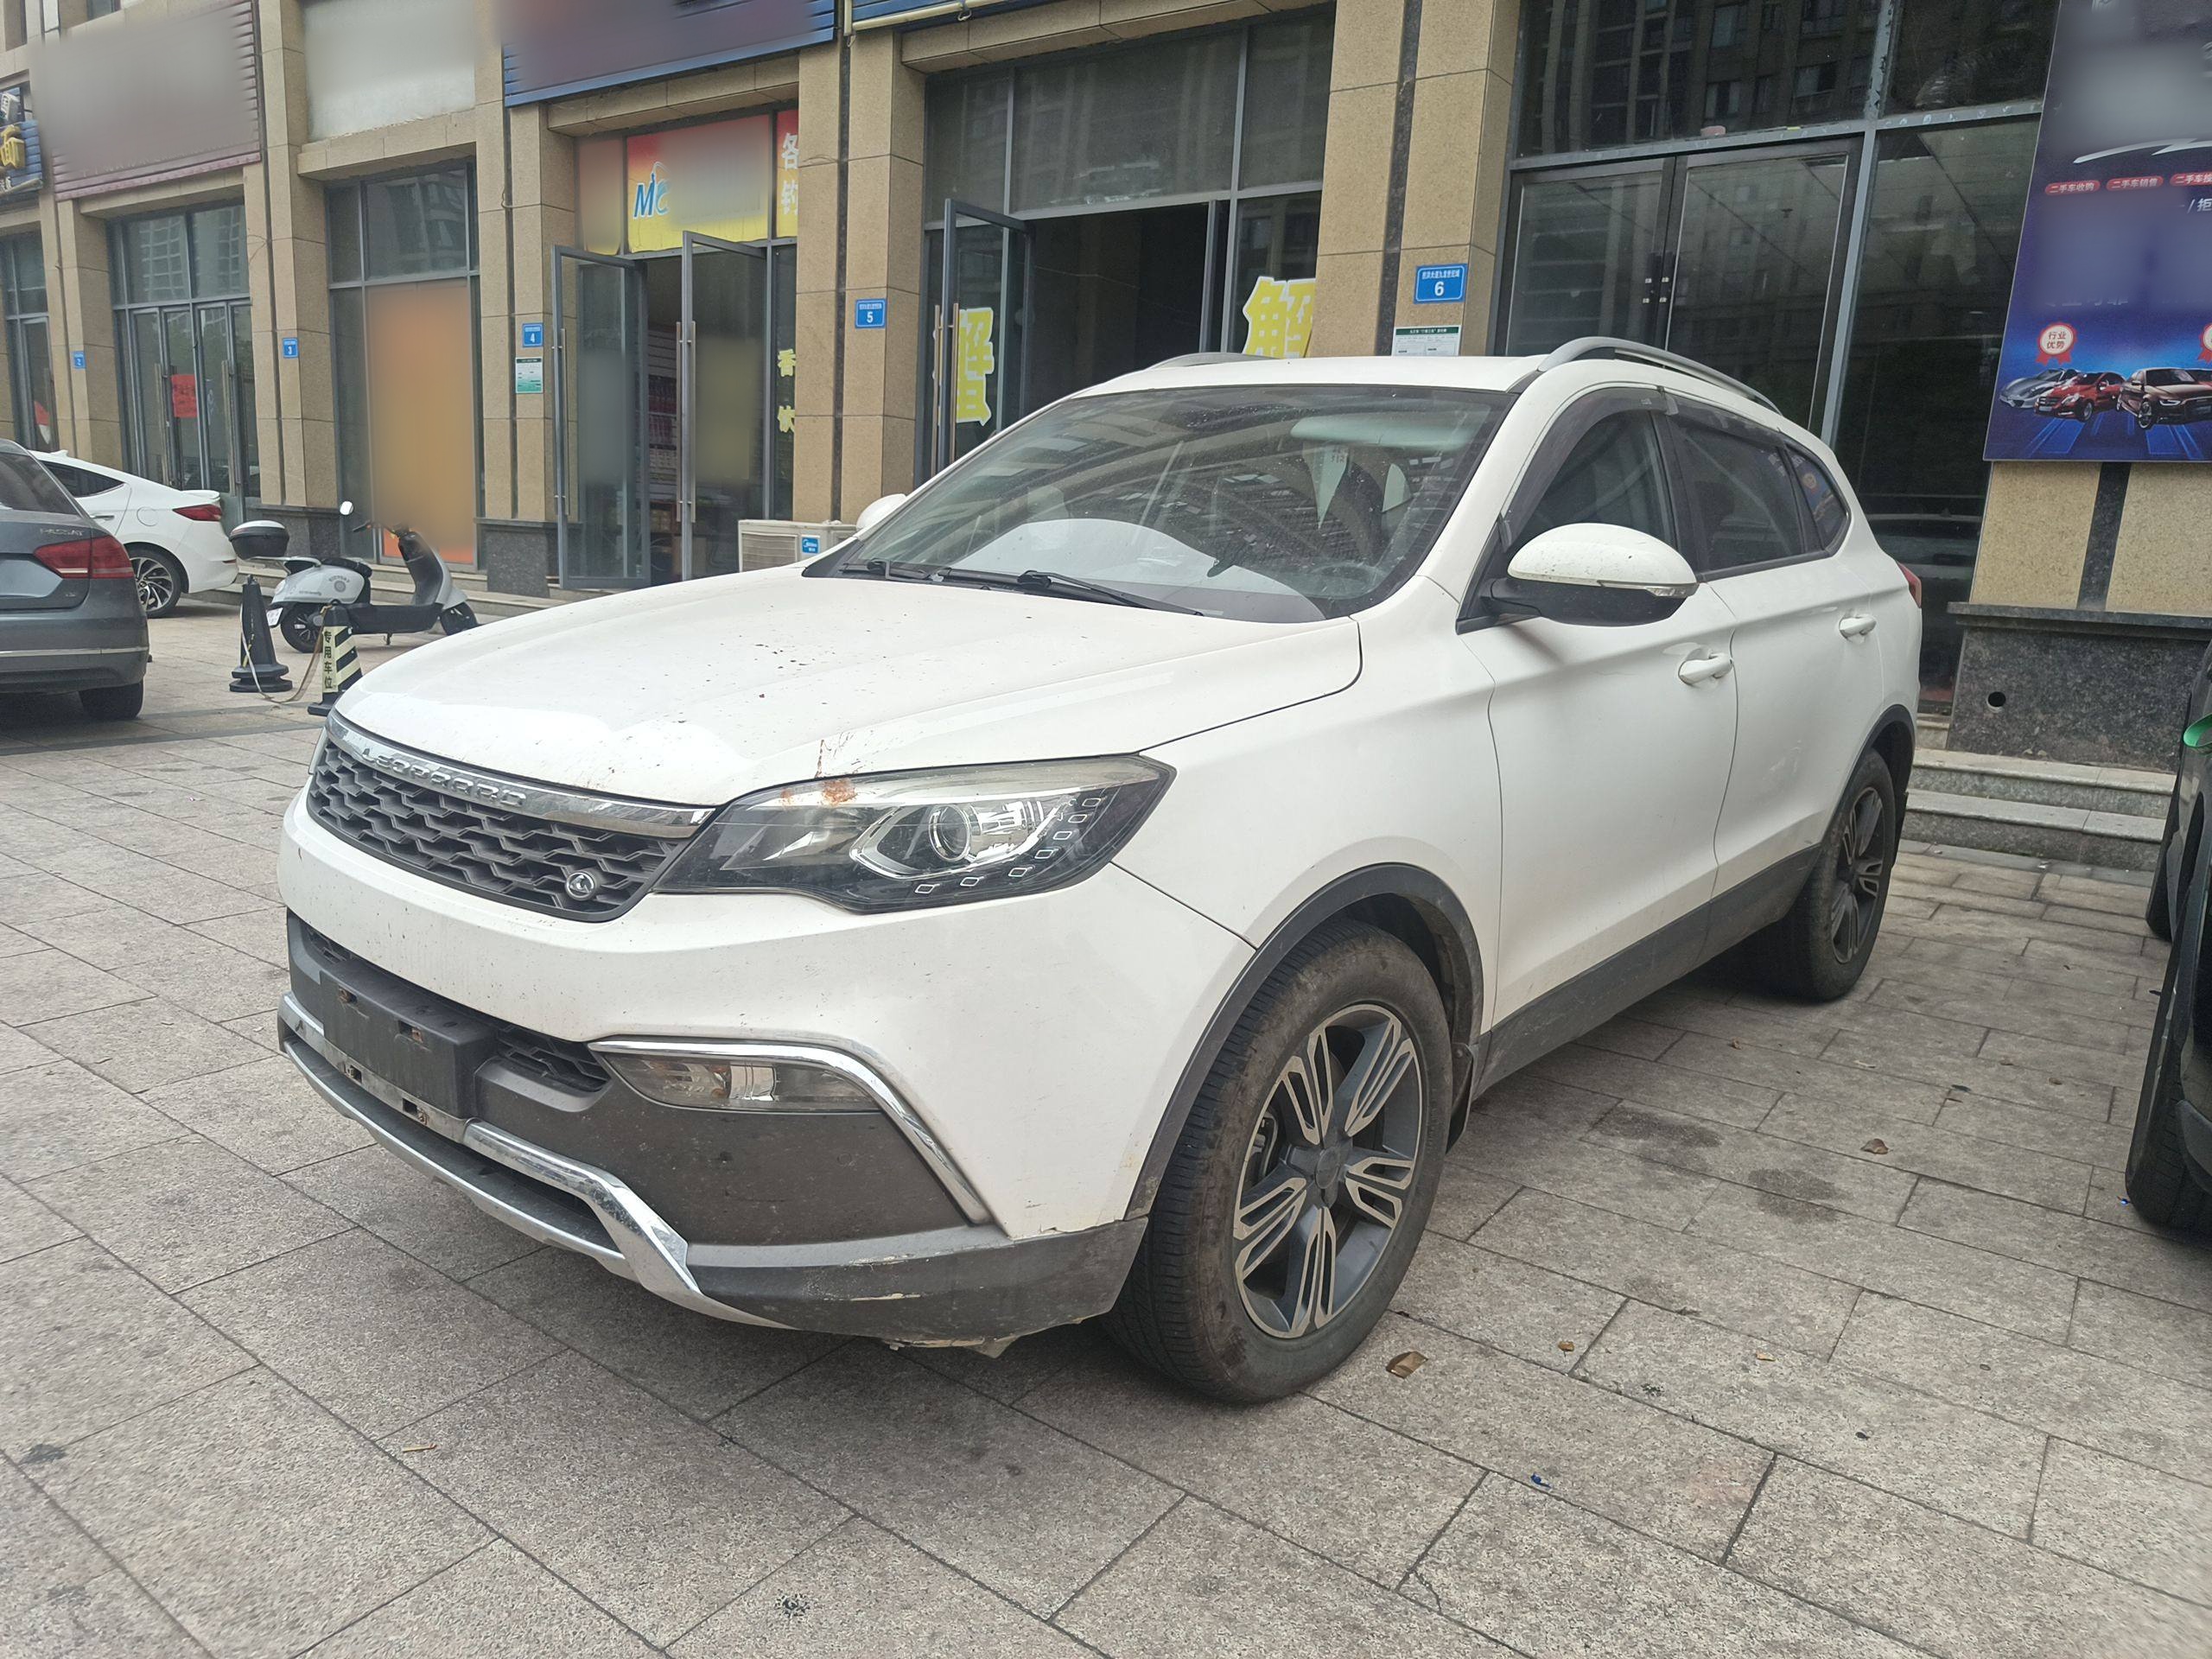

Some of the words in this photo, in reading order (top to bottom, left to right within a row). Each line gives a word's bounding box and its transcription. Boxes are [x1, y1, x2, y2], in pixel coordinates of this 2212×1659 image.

[2050, 181, 2094, 194] 二手车收购
[2111, 177, 2158, 189] 二手车销售
[1434, 281, 1445, 296] 6
[867, 311, 874, 323] 5
[530, 333, 536, 343] 4
[2048, 331, 2067, 340] 行业
[2046, 340, 2065, 350] 优势
[323, 630, 334, 690] 专用车位
[361, 747, 527, 809] LEOPAARD
